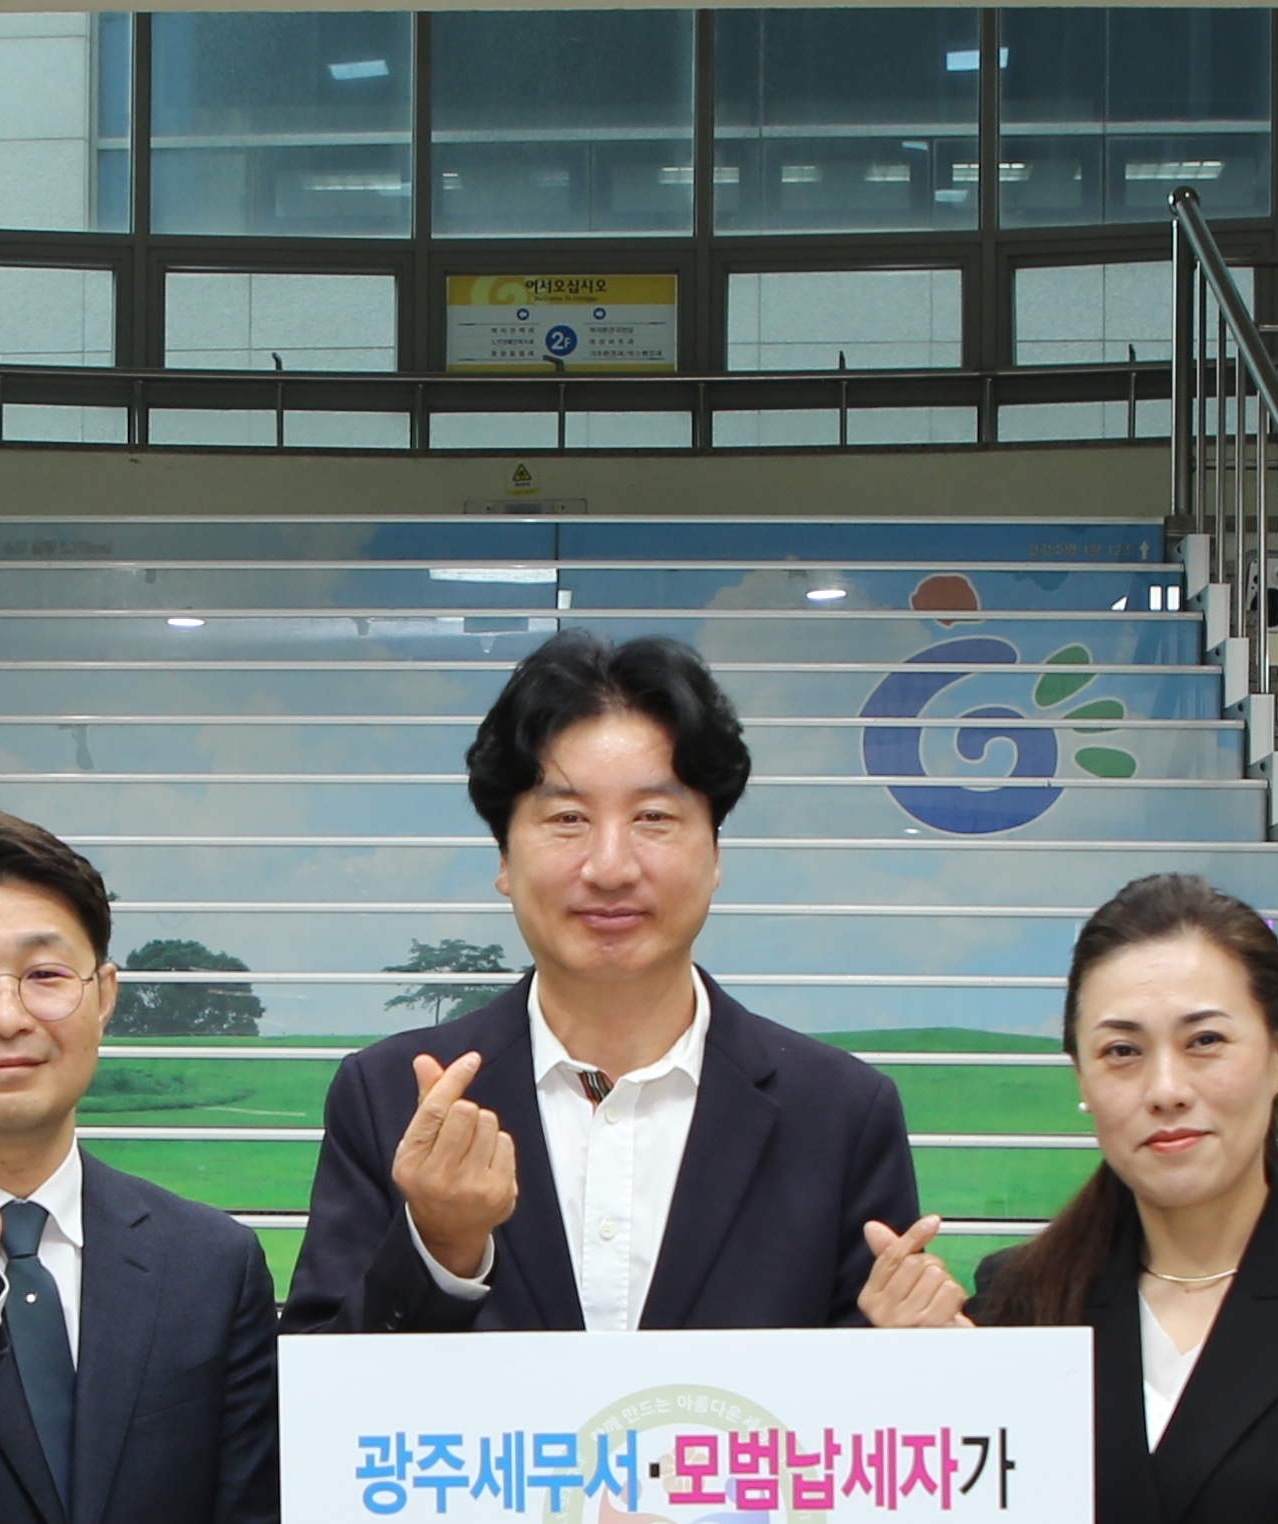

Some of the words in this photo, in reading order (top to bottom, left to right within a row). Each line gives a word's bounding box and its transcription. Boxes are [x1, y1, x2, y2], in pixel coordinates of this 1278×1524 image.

[525, 278, 607, 293] 어서오십시오
[551, 331, 571, 350] 2F
[622, 1396, 671, 1424] 만드는
[677, 1394, 742, 1423] 아름다운
[354, 1427, 1016, 1514] 광주세무서·모범납세자가
